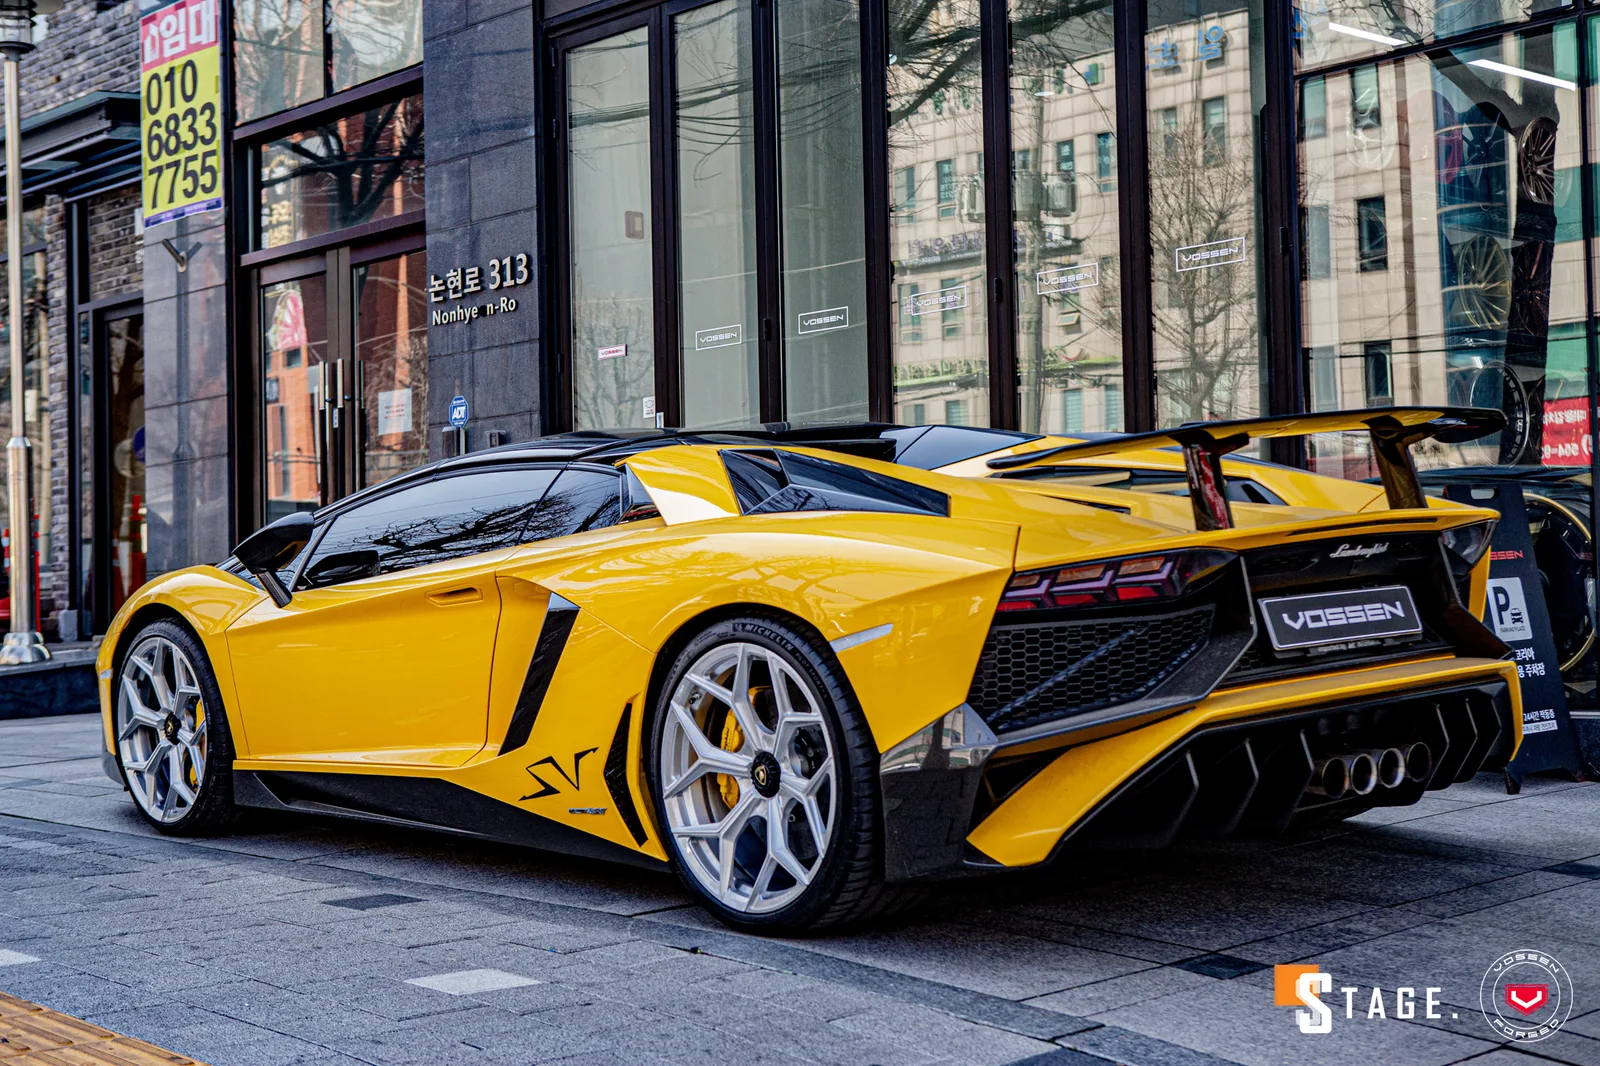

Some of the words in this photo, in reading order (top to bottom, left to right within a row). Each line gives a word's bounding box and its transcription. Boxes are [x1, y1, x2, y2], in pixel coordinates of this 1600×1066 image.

[146, 59, 198, 116] 010
[147, 101, 217, 162] 6833
[148, 149, 218, 210] 7755
[1182, 246, 1239, 262] VOSSEN
[428, 266, 482, 303] 논현로
[488, 252, 529, 290] 313
[1042, 271, 1093, 286] VOSSEN
[916, 293, 962, 308] VOSSEN
[802, 313, 845, 326] VOSSEN
[700, 331, 738, 344] VOSSEN
[451, 406, 466, 420] ADT
[1490, 550, 1524, 561] SSEN
[1491, 586, 1511, 626] P
[1282, 600, 1406, 631] VOSSEN
[744, 624, 795, 652] MICHELIN
[1514, 646, 1535, 661] 코리아
[1524, 662, 1546, 677] 주차장
